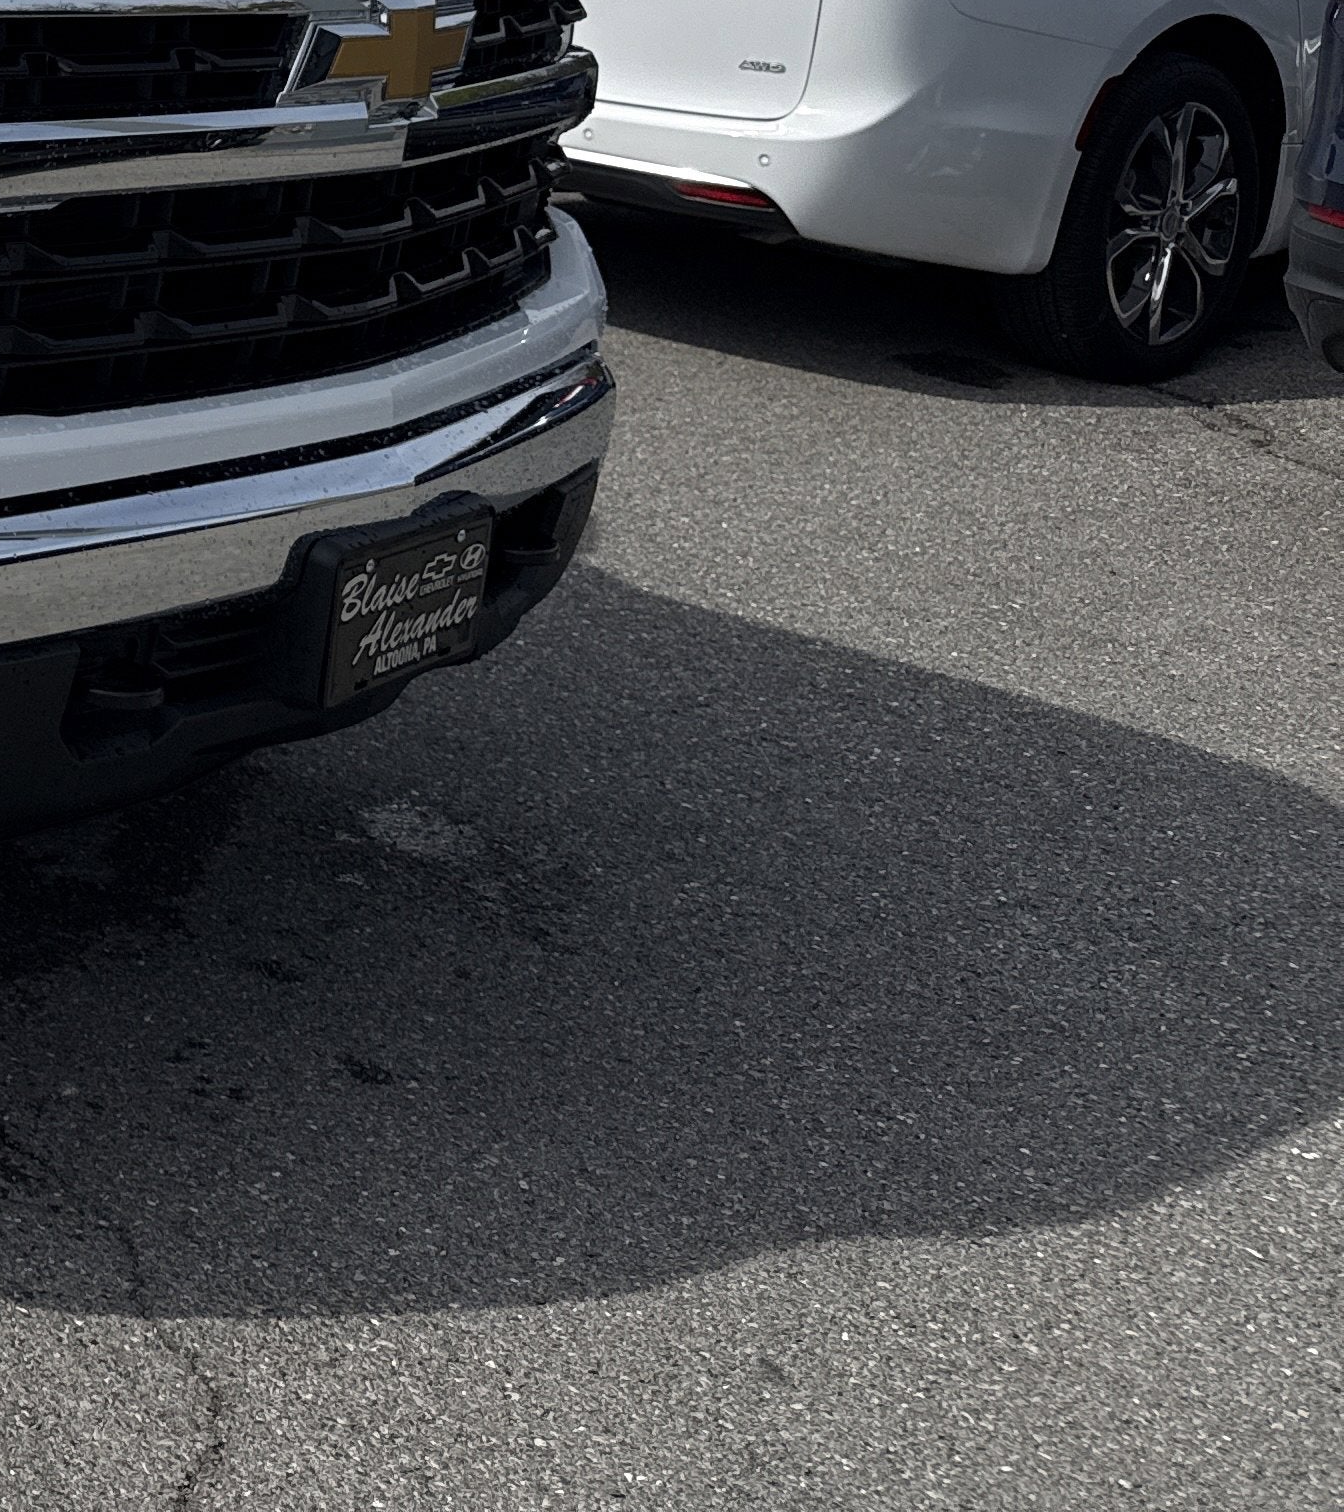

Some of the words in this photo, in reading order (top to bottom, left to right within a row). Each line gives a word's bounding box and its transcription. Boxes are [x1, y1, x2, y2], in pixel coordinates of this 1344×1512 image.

[738, 59, 787, 74] AWD
[340, 572, 421, 623] Blaise
[352, 588, 479, 666] Alexander
[423, 635, 437, 656] PA
